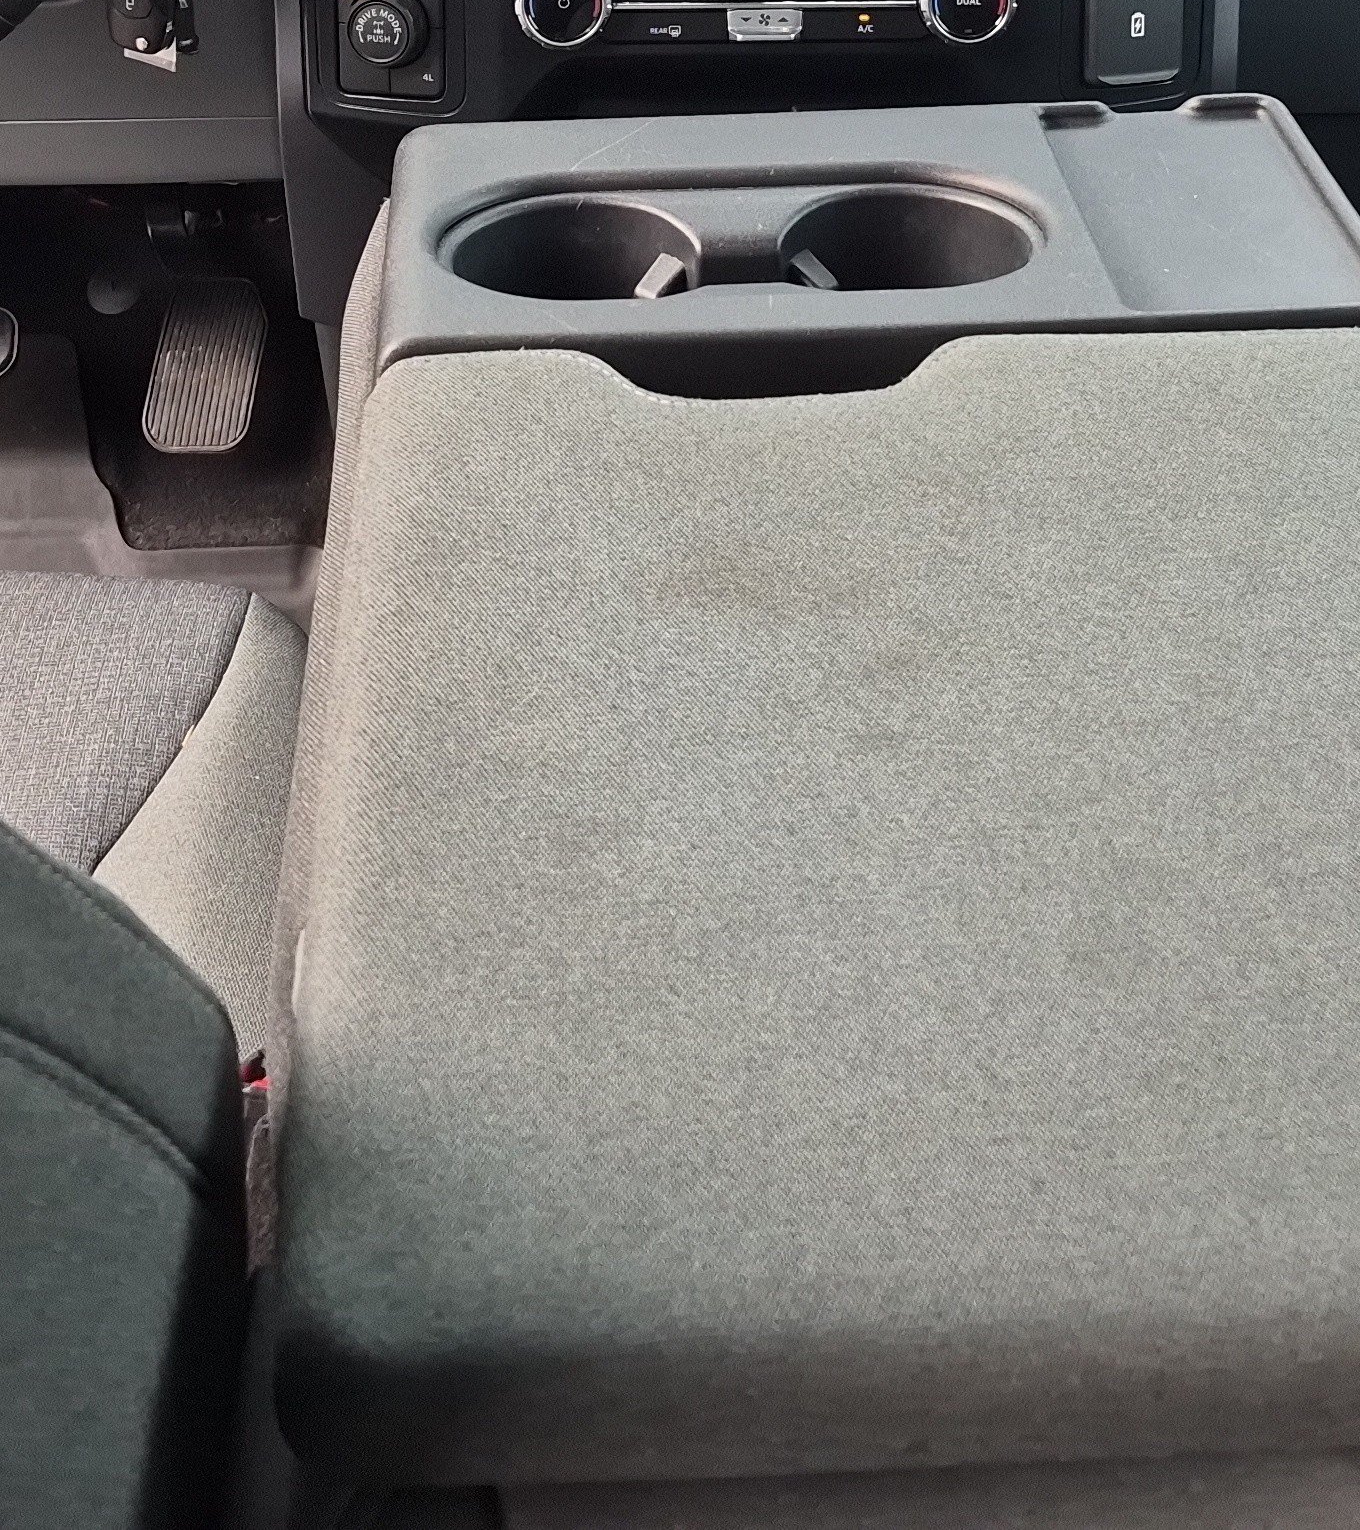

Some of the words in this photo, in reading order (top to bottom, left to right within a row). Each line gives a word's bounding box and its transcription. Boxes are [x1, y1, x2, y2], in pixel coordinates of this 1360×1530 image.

[355, 8, 378, 32] DRIVE
[379, 8, 402, 34] MODE
[857, 24, 874, 33] A/C
[366, 34, 391, 43] PUSH
[422, 73, 435, 82] 4L
